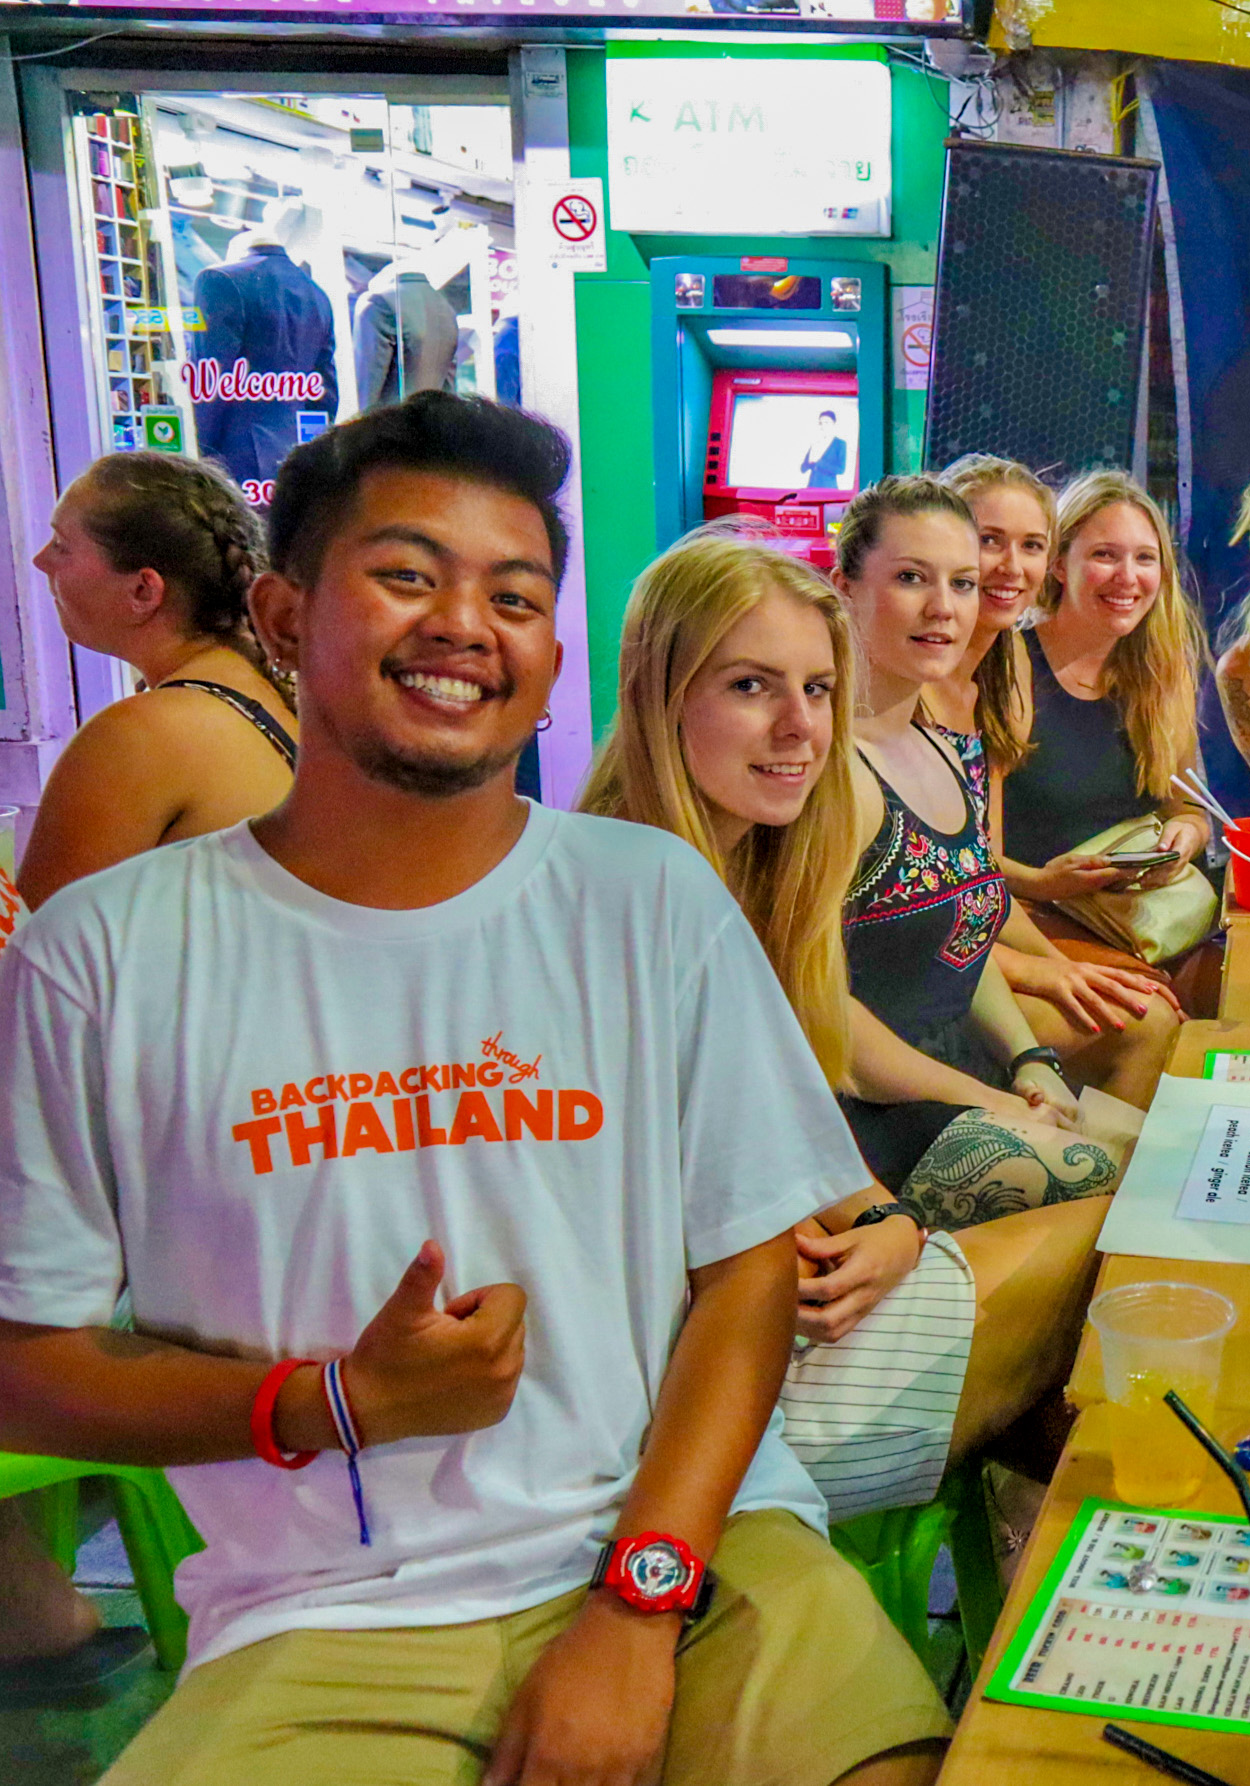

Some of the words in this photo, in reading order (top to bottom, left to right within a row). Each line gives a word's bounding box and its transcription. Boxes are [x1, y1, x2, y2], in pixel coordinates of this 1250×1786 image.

[673, 100, 767, 133] ATM
[181, 357, 325, 404] Welcome
[251, 1062, 504, 1117] BACKPACKING
[481, 1031, 543, 1085] through
[232, 1089, 604, 1176] THAILAND
[1226, 1119, 1240, 1138] peach
[1219, 1138, 1238, 1158] icetea
[1207, 1167, 1228, 1190] ginger
[1205, 1191, 1222, 1203] ale
